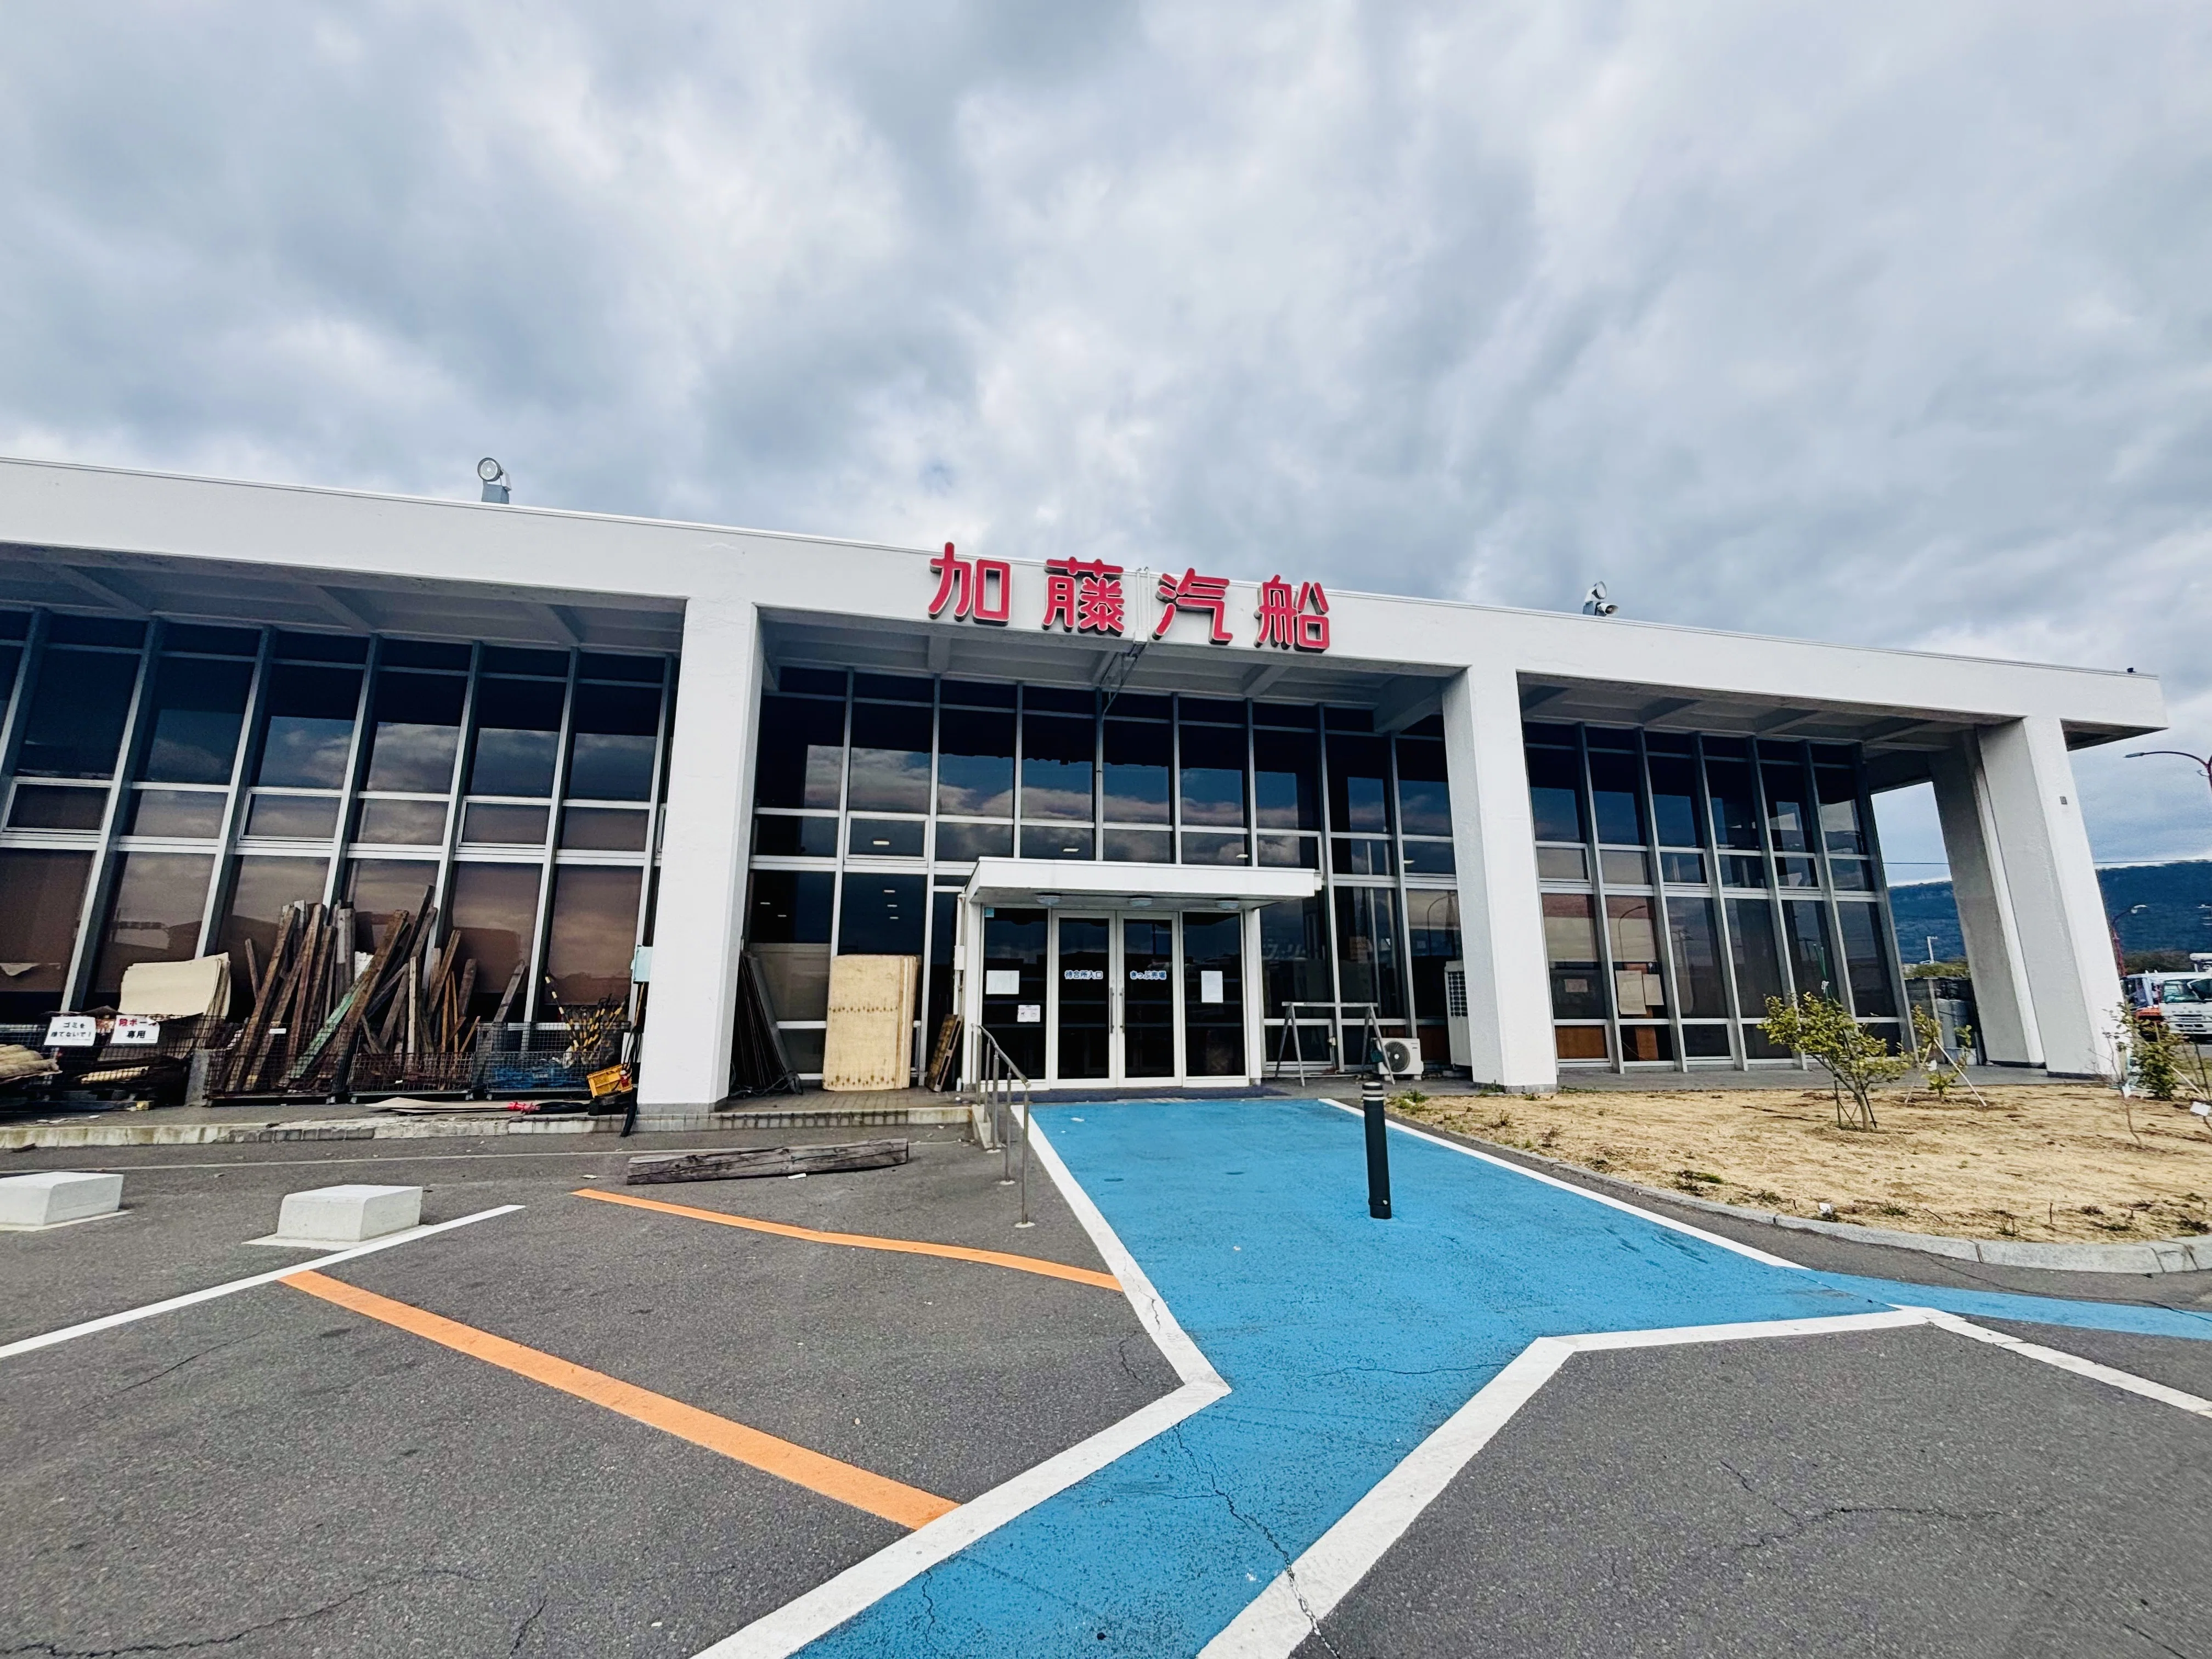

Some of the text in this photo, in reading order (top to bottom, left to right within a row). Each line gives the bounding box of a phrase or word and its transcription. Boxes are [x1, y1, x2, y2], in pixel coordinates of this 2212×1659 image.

[928, 541, 1330, 652] 加藤汽船
[1065, 970, 1102, 979] 待合所入口
[1131, 970, 1166, 979] きっぷ売場
[126, 1030, 146, 1039] 専用
